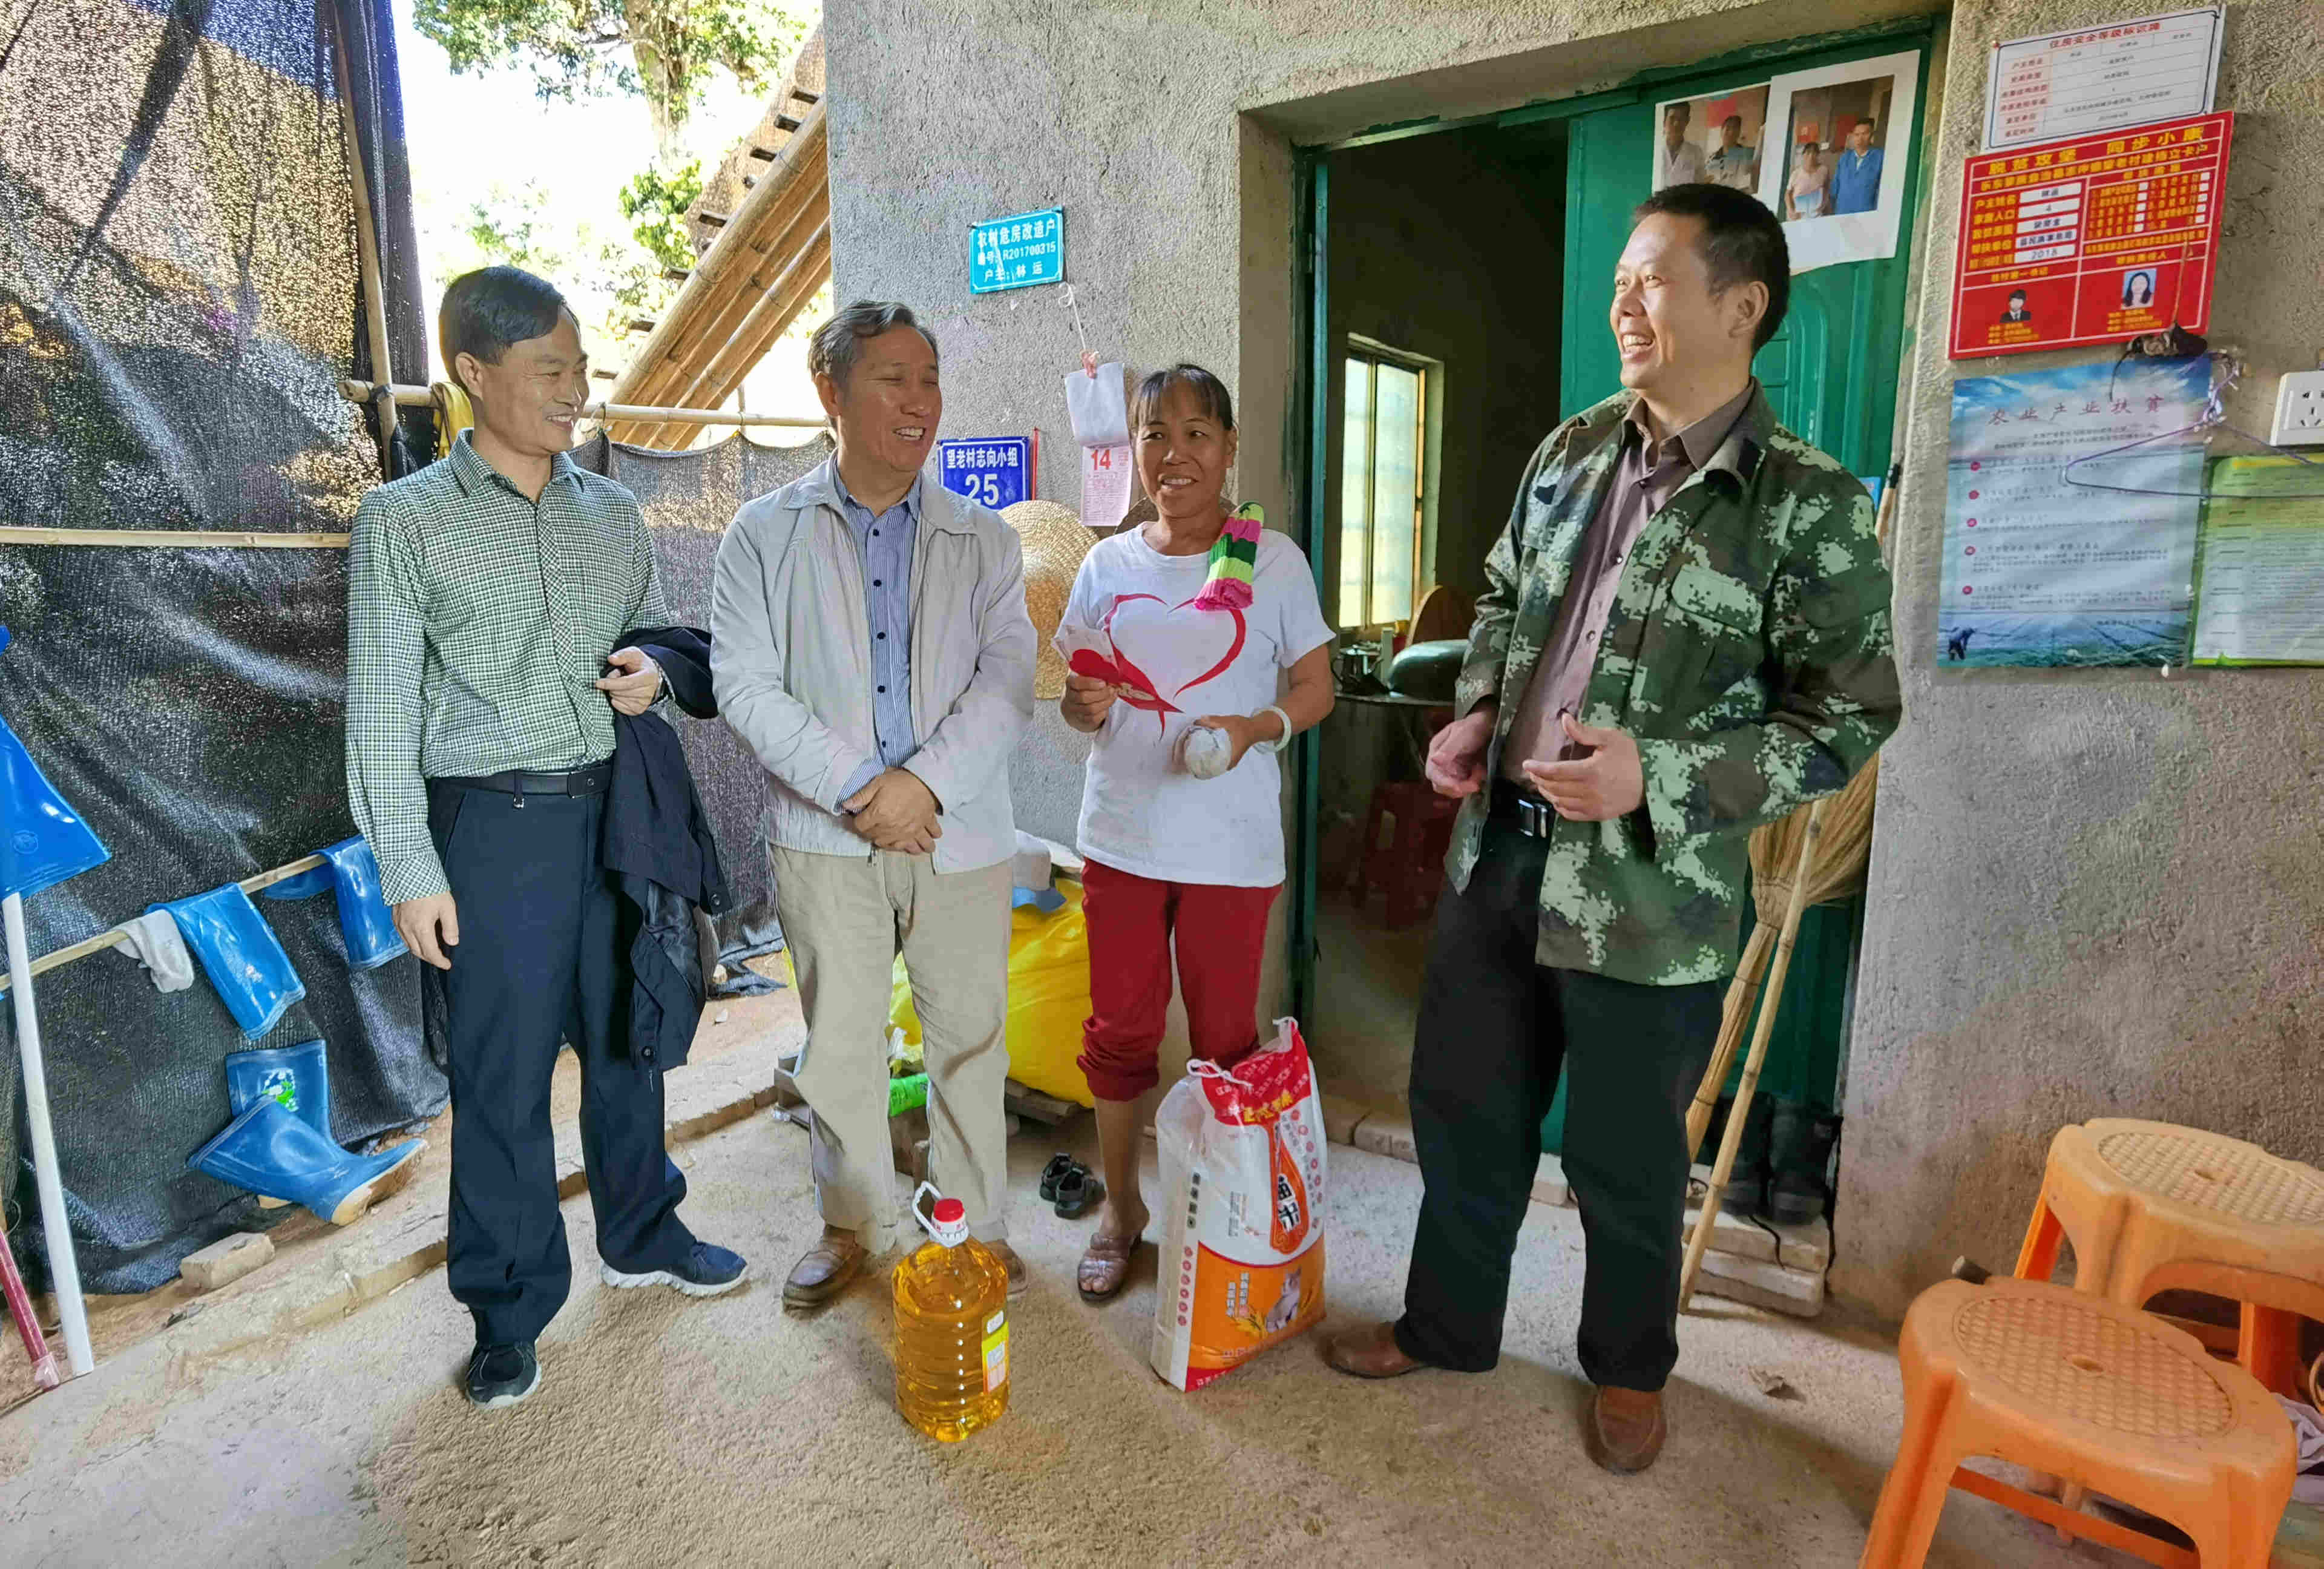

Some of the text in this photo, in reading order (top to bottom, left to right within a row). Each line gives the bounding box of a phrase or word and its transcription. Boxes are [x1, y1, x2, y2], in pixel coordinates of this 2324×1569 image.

[1988, 126, 2205, 175] 脱贫攻坚 同步小康
[977, 218, 1055, 248] 农村危房改造户
[946, 446, 1019, 469] 望老村志向小组
[1091, 449, 1111, 470] 14
[965, 473, 999, 506] 25
